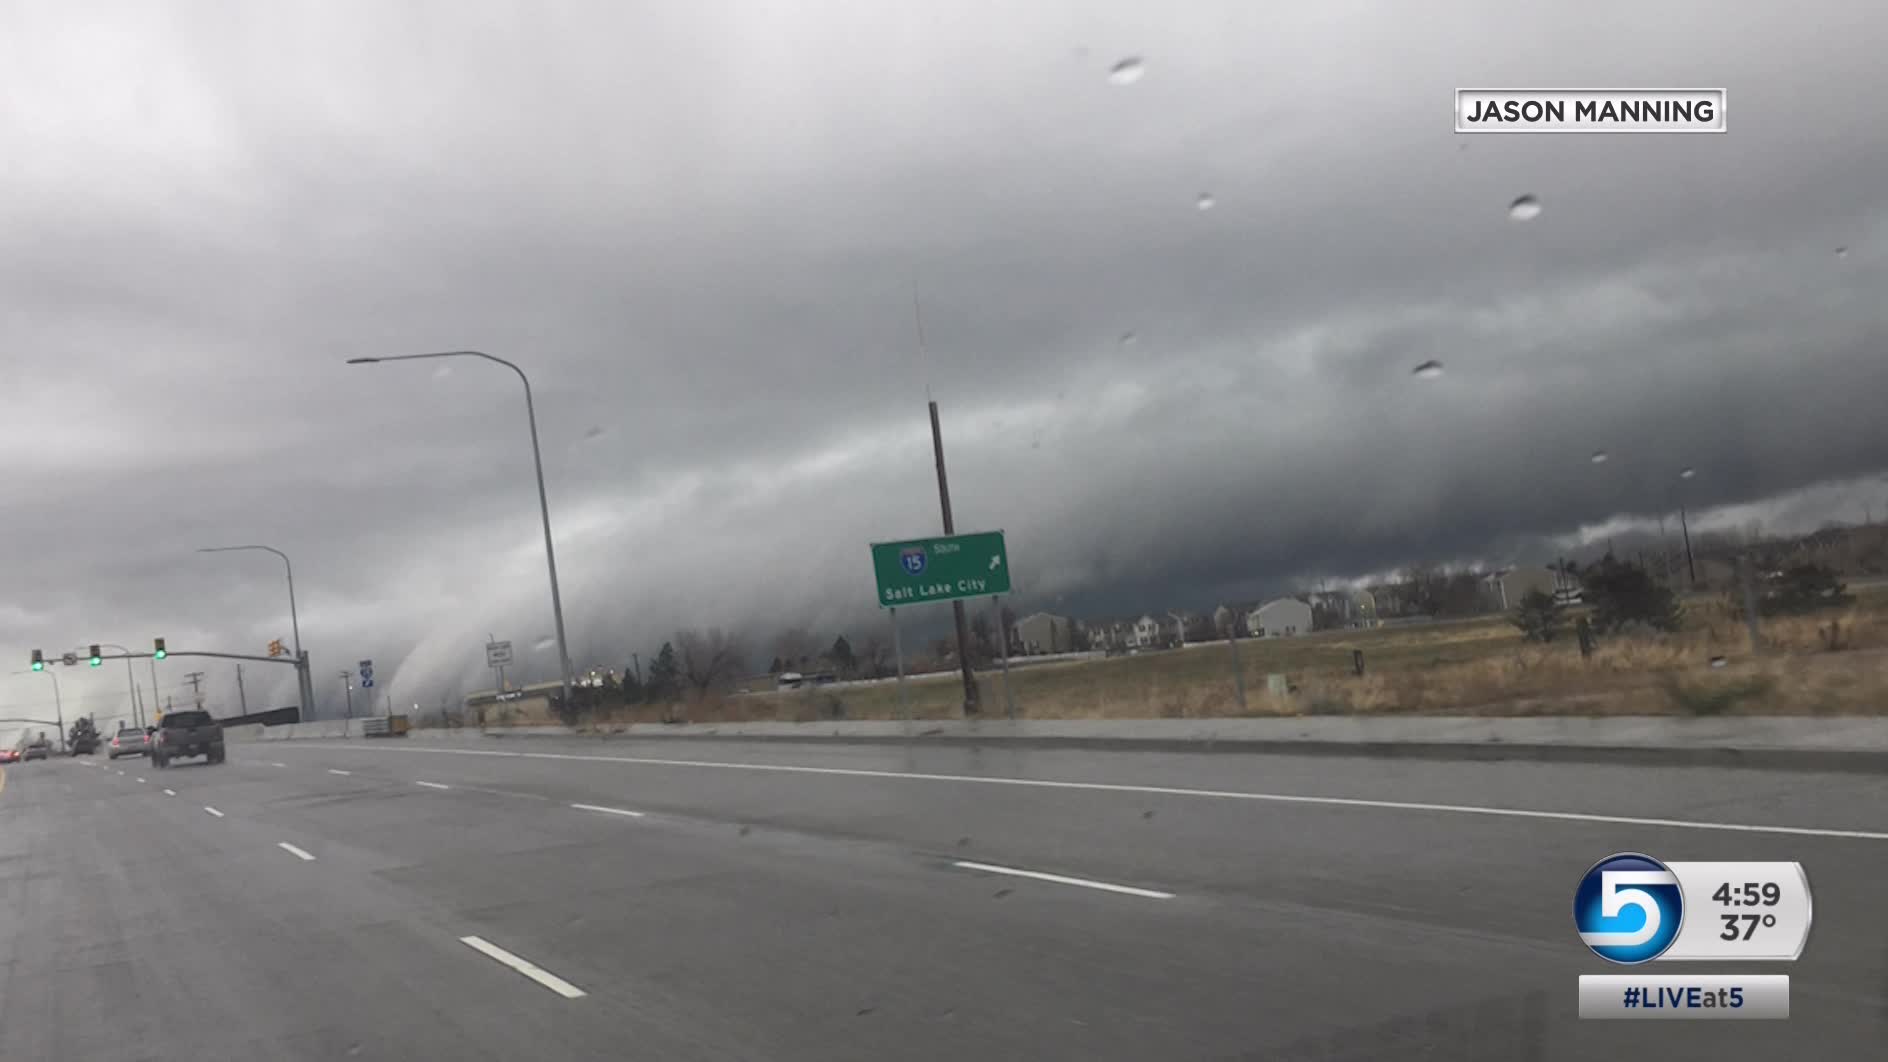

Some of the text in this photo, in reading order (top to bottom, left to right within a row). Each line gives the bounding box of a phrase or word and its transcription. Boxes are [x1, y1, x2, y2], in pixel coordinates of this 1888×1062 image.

[905, 555, 922, 570] 15
[885, 579, 986, 600] Salt Lake City
